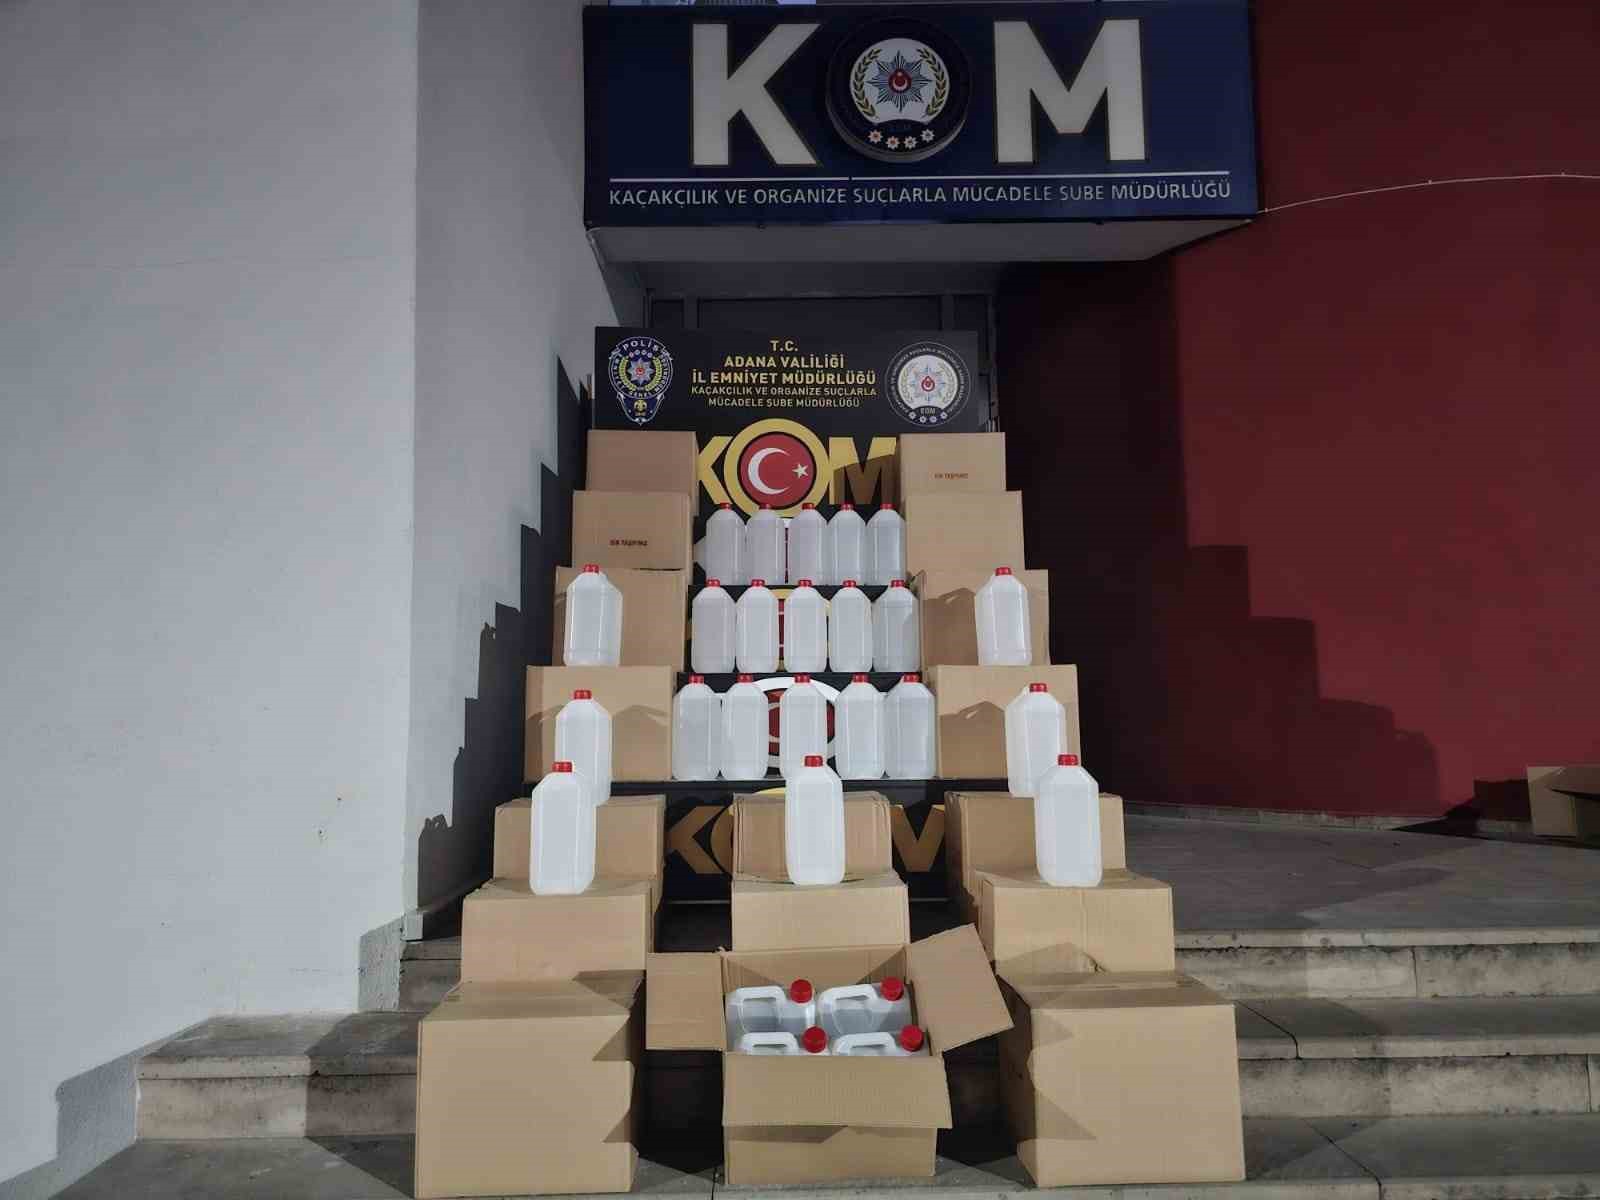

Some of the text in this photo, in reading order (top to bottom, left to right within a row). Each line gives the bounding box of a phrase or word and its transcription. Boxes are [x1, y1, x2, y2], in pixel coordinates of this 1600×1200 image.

[609, 189, 719, 208] KAÇAKÇILIK
[725, 188, 748, 205] VE
[753, 185, 847, 204] ORGANİZE
[1111, 179, 1231, 201] MÜDÜRLÜĞÜ
[770, 340, 799, 352] T.C.
[724, 353, 845, 370] ADANA VALİLİĞİ
[692, 369, 877, 385] İL EMNİYET MÜDÜRLÜĞÜ
[754, 386, 768, 396] VE
